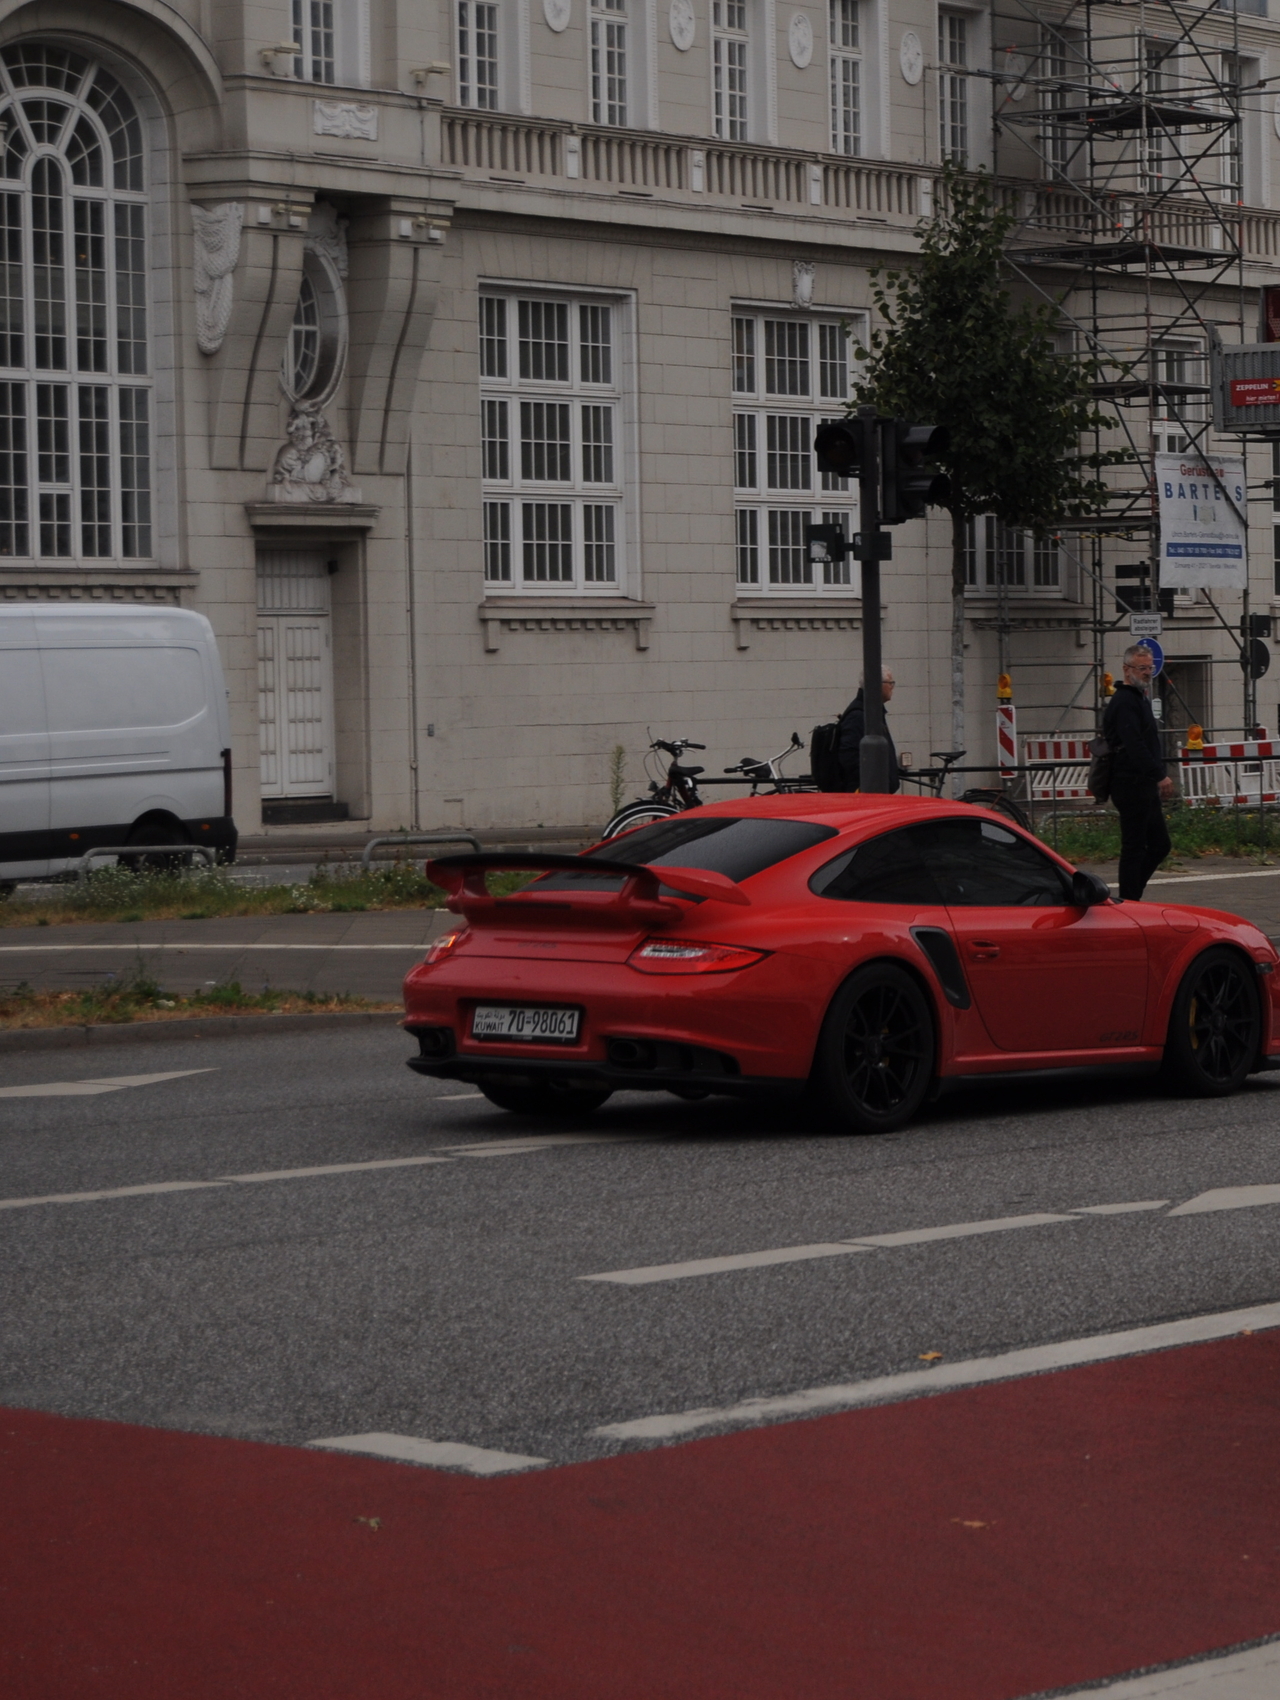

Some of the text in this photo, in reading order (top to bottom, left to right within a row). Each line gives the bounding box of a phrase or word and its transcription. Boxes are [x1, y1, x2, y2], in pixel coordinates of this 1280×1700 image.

[1235, 383, 1269, 391] ZEPPELIN
[1180, 463, 1224, 477] Gerüstau
[1164, 482, 1242, 502] BARTES
[475, 1021, 505, 1032] KUWAIT
